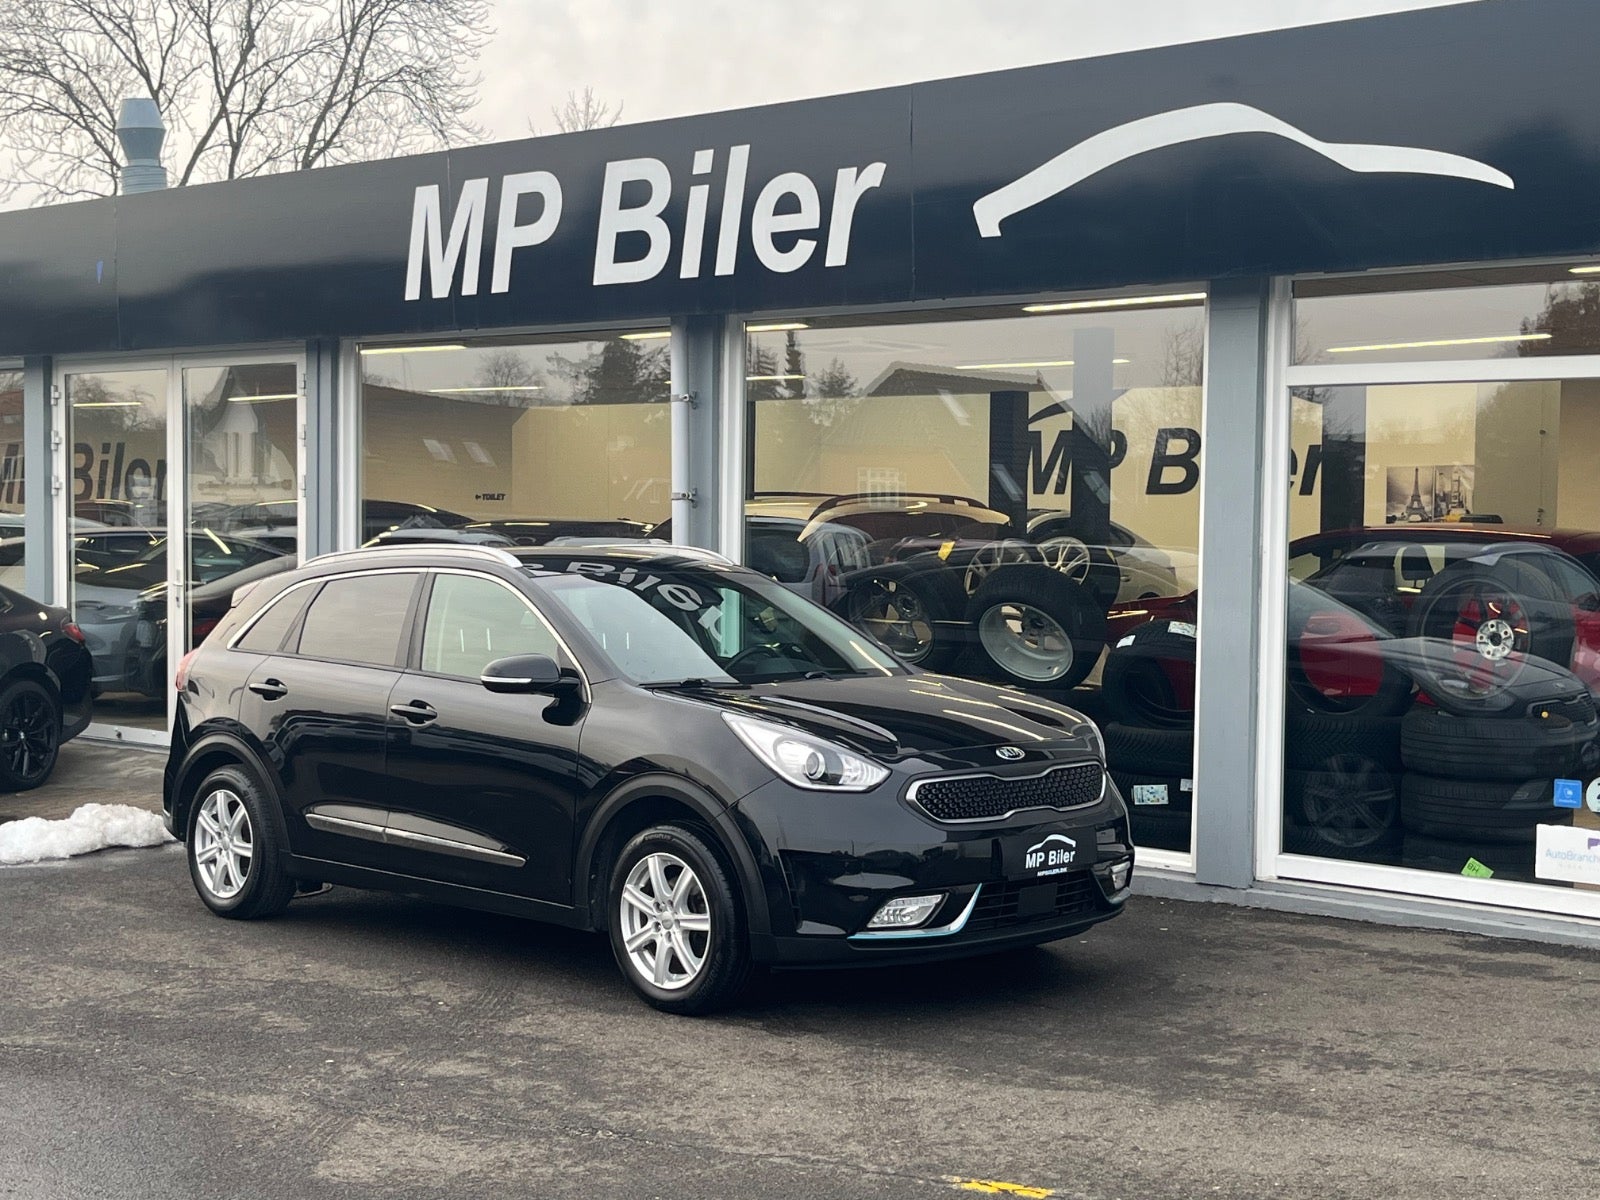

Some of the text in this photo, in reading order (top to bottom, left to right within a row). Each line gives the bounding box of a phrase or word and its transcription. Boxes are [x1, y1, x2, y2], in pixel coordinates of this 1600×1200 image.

[404, 144, 887, 301] MP Biler
[482, 493, 506, 501] TOILET
[1025, 849, 1076, 869] MP Biler
[1545, 848, 1600, 864] AutoBranch
